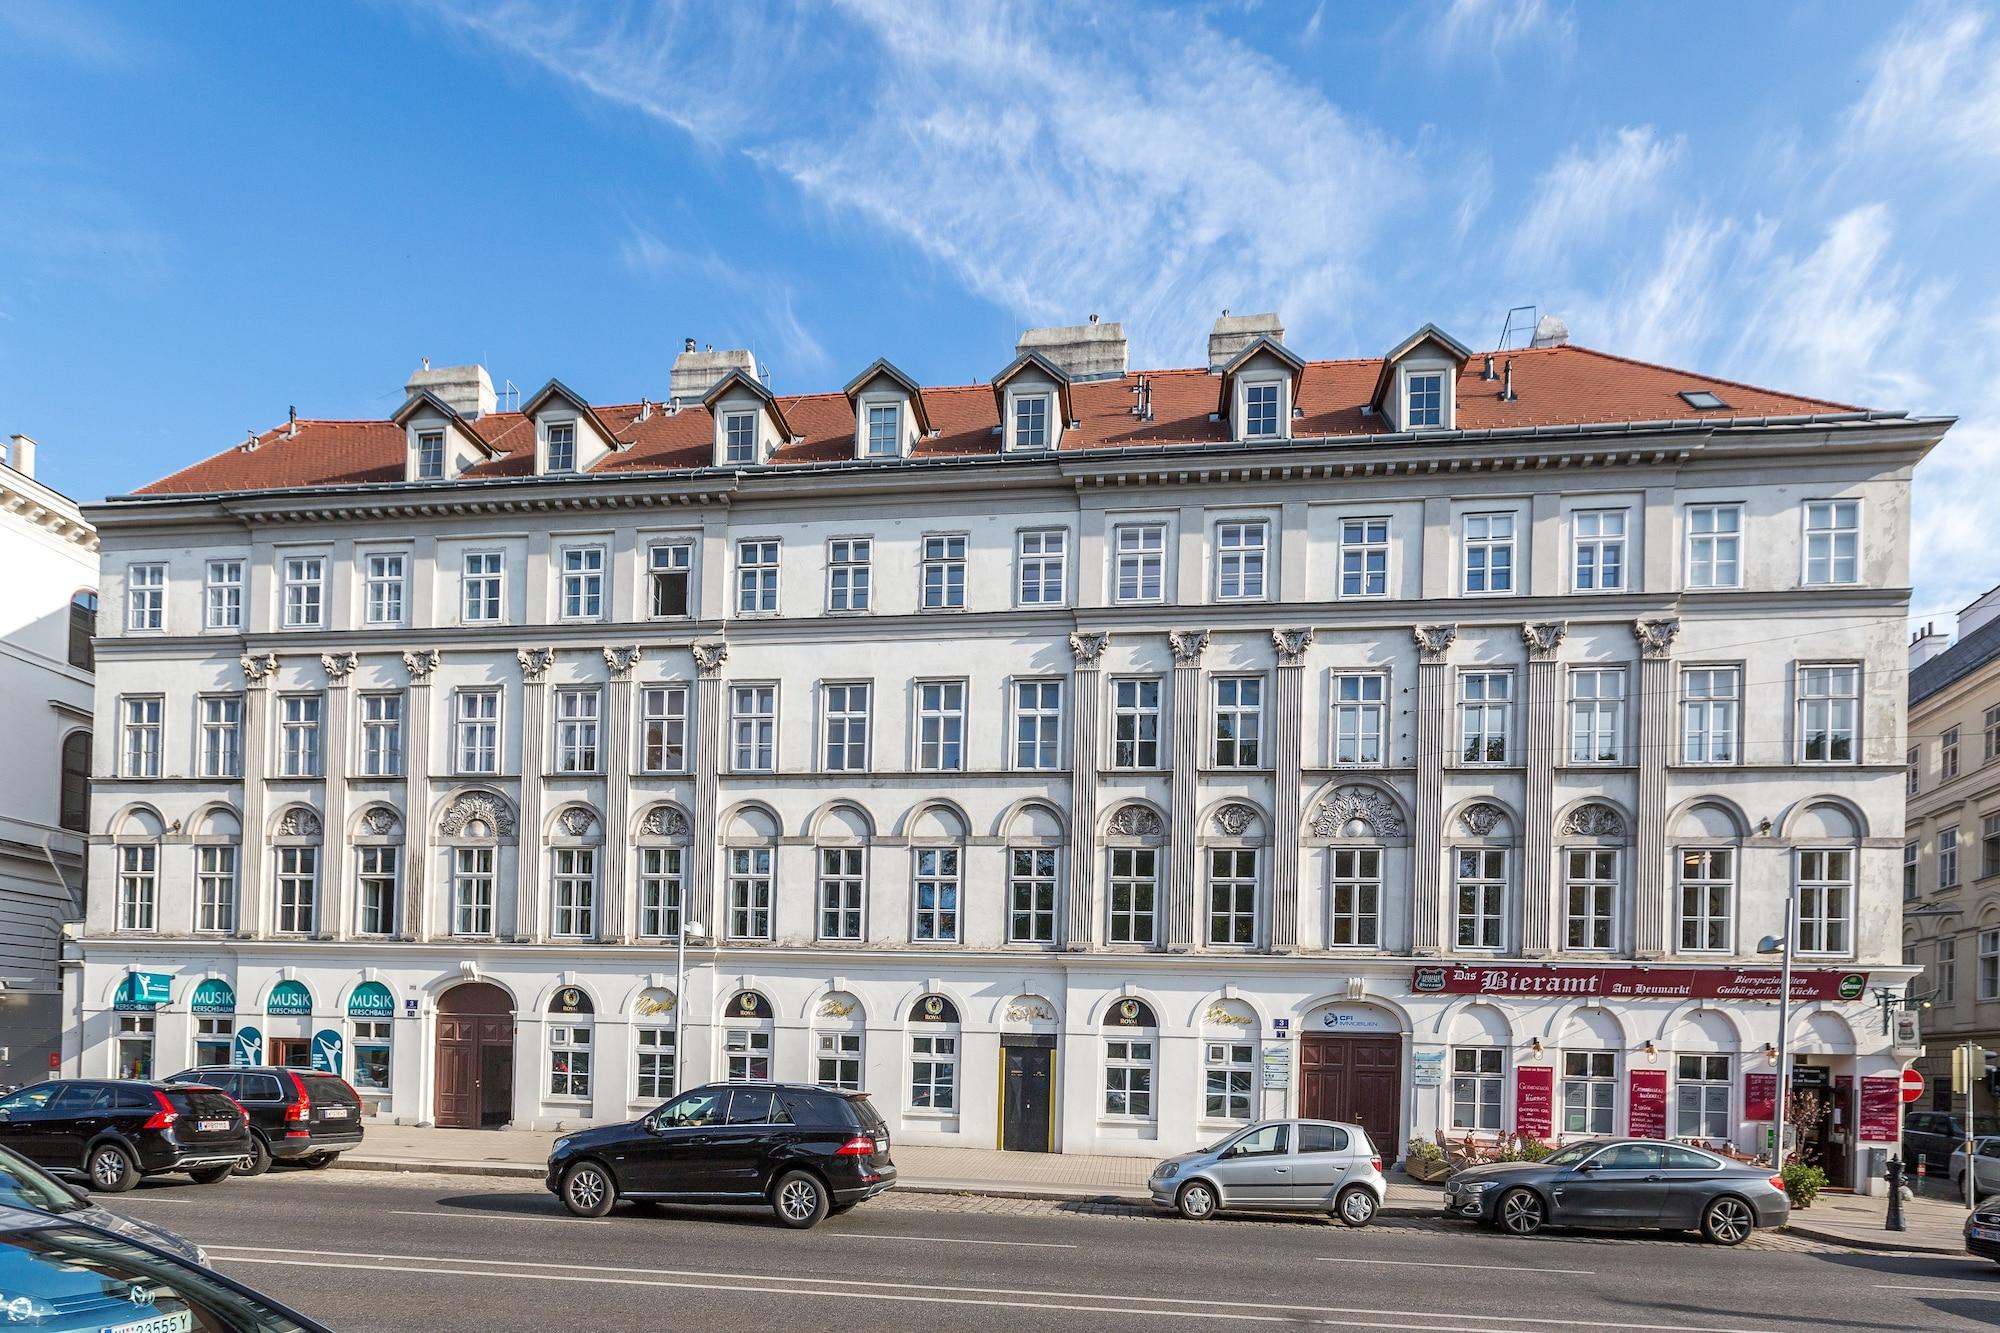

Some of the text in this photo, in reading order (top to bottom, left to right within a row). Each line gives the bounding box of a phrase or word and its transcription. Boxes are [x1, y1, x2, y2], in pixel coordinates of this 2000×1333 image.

[1452, 969, 1599, 993] Das Bieramt
[1611, 983, 1690, 994] Am Heumarkt
[1716, 985, 1820, 996] Gutbürgerlich Küche
[193, 991, 234, 1004] MUSIK
[269, 993, 311, 1006] MUSIK
[350, 994, 392, 1008] MUSIK
[192, 1005, 234, 1013] KERSCHBAUM
